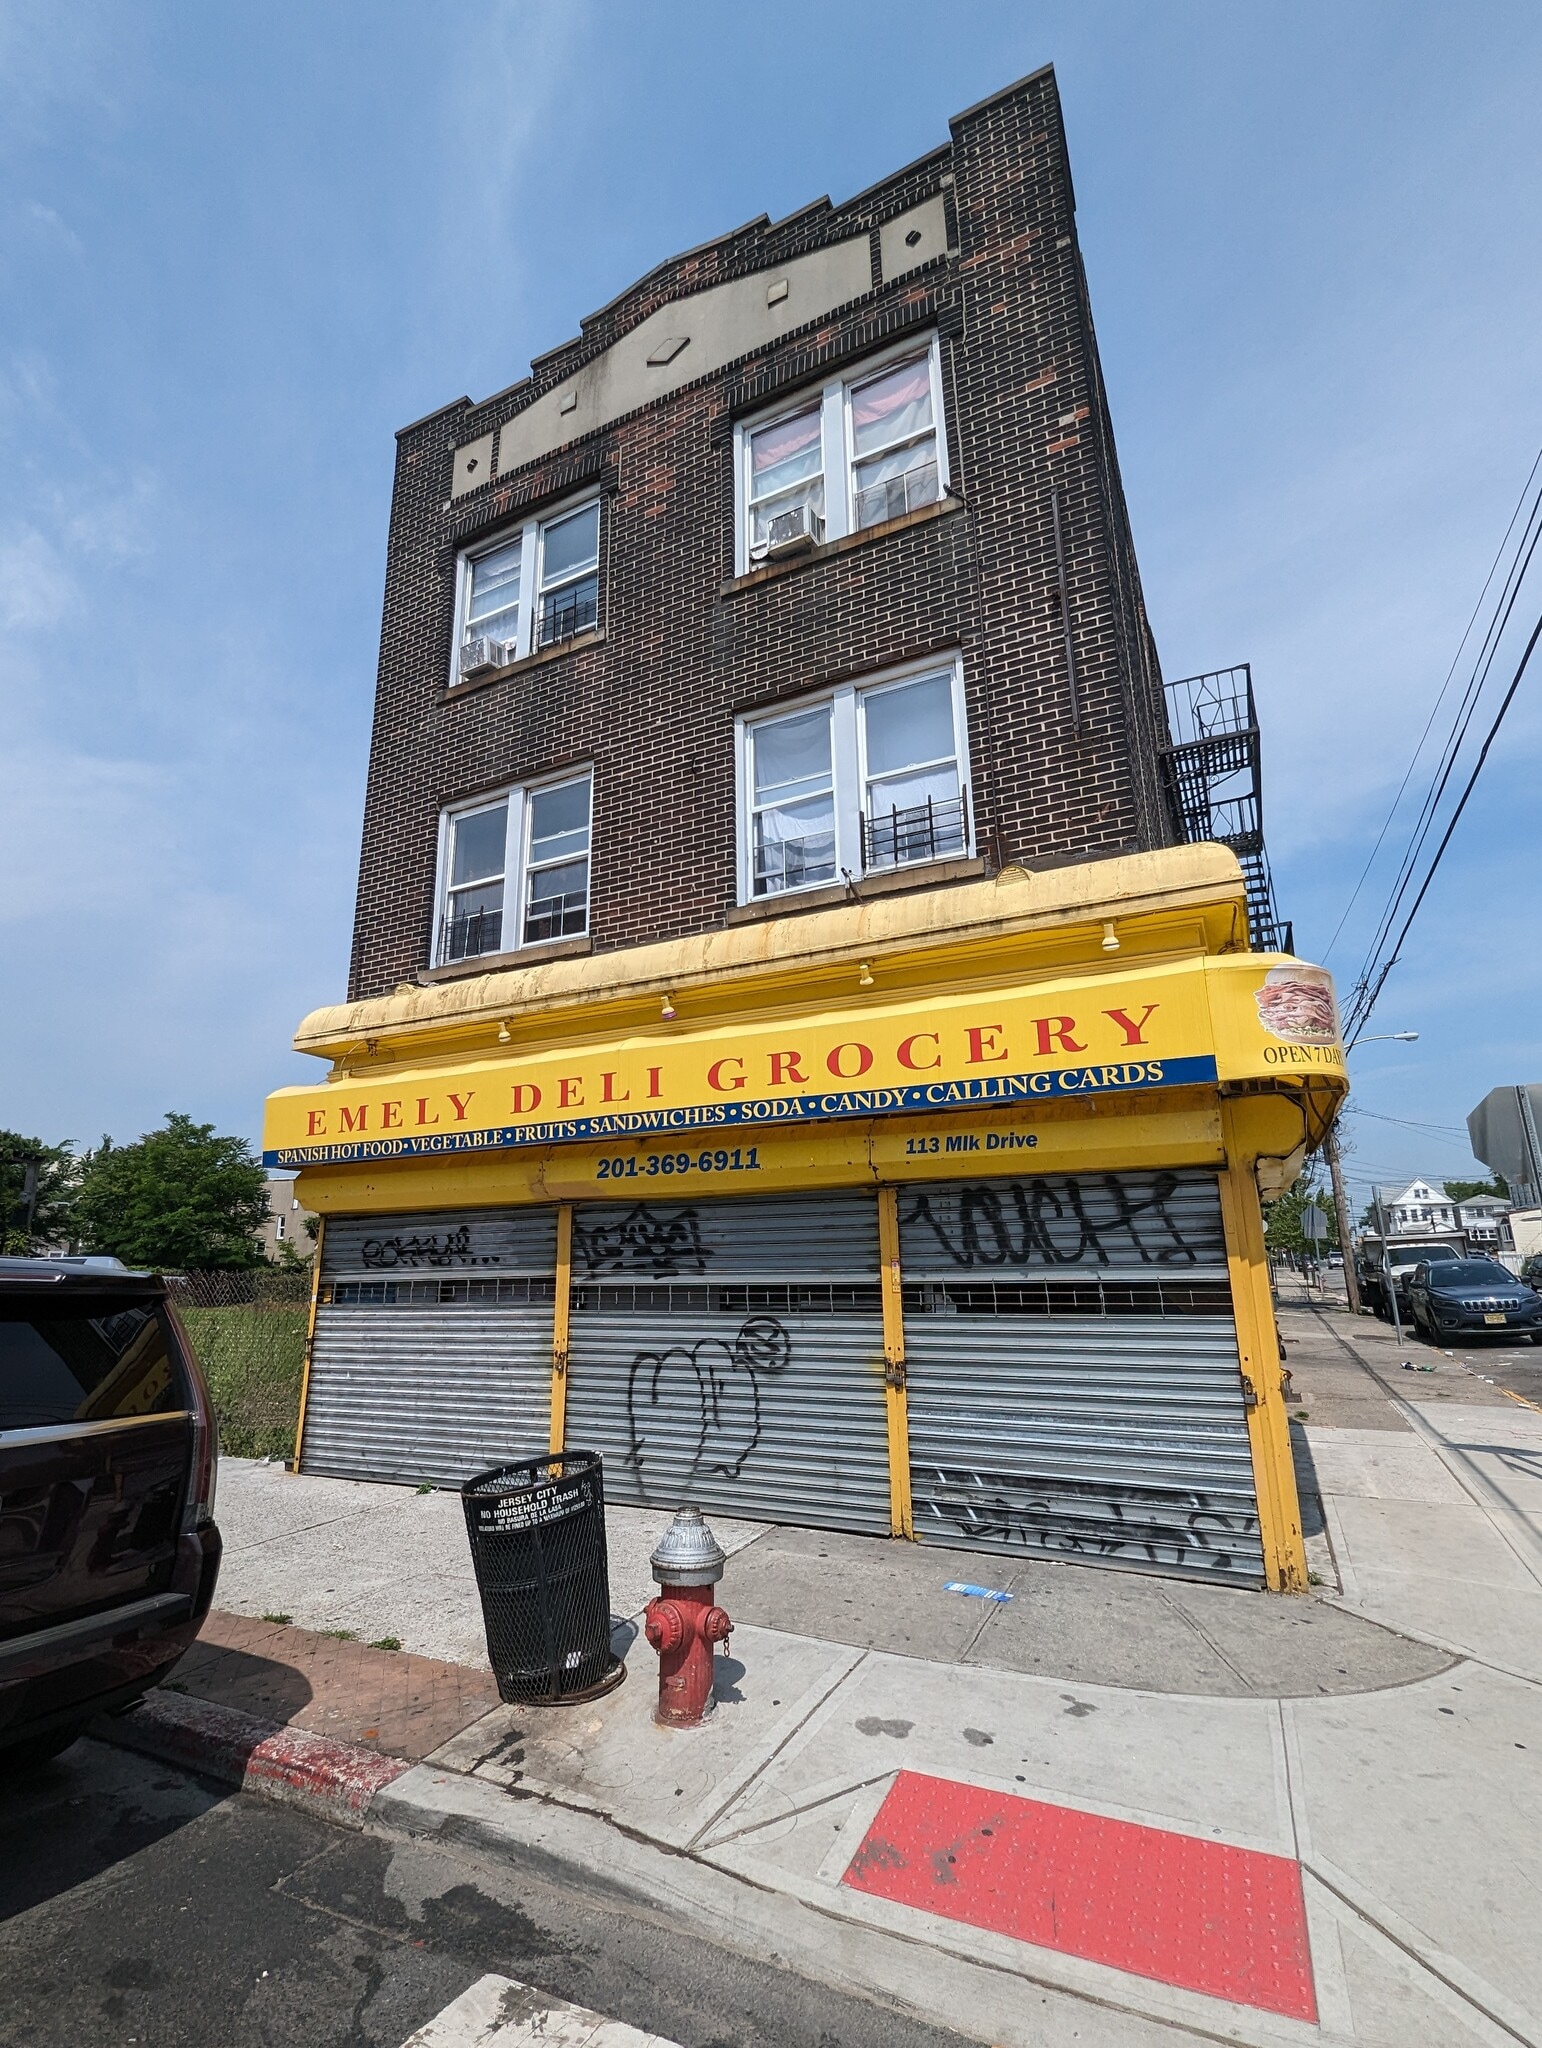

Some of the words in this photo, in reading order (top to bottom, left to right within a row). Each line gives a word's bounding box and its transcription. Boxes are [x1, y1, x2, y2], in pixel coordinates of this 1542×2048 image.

[306, 1091, 476, 1137] EMELY
[510, 1066, 664, 1114] DELI
[707, 1003, 1160, 1091] GROCERY
[1263, 1046, 1313, 1064] OPEN
[1314, 1047, 1320, 1062] 7
[277, 1146, 328, 1164] SPANISH
[333, 1142, 363, 1160] HOT
[363, 1139, 402, 1157] FOOD
[412, 1129, 504, 1152] VEGETABLE
[514, 1121, 577, 1142] FRUITS
[590, 1105, 727, 1134] SANDWICHES
[741, 1098, 805, 1120] SODA
[820, 1088, 911, 1113] CANDY
[926, 1073, 1053, 1104] CALLING
[1058, 1061, 1165, 1091] CARDS
[905, 1136, 940, 1154] 113
[945, 1135, 981, 1152] Mlk
[986, 1131, 1039, 1151] Drive
[596, 1147, 761, 1180] 201-369-6911
[480, 1510, 491, 1519] NO
[494, 1500, 548, 1519] HOUSEHOLD
[551, 1488, 579, 1506] TRASH
[498, 1493, 533, 1509] JERSEY
[536, 1485, 558, 1500] CITY
